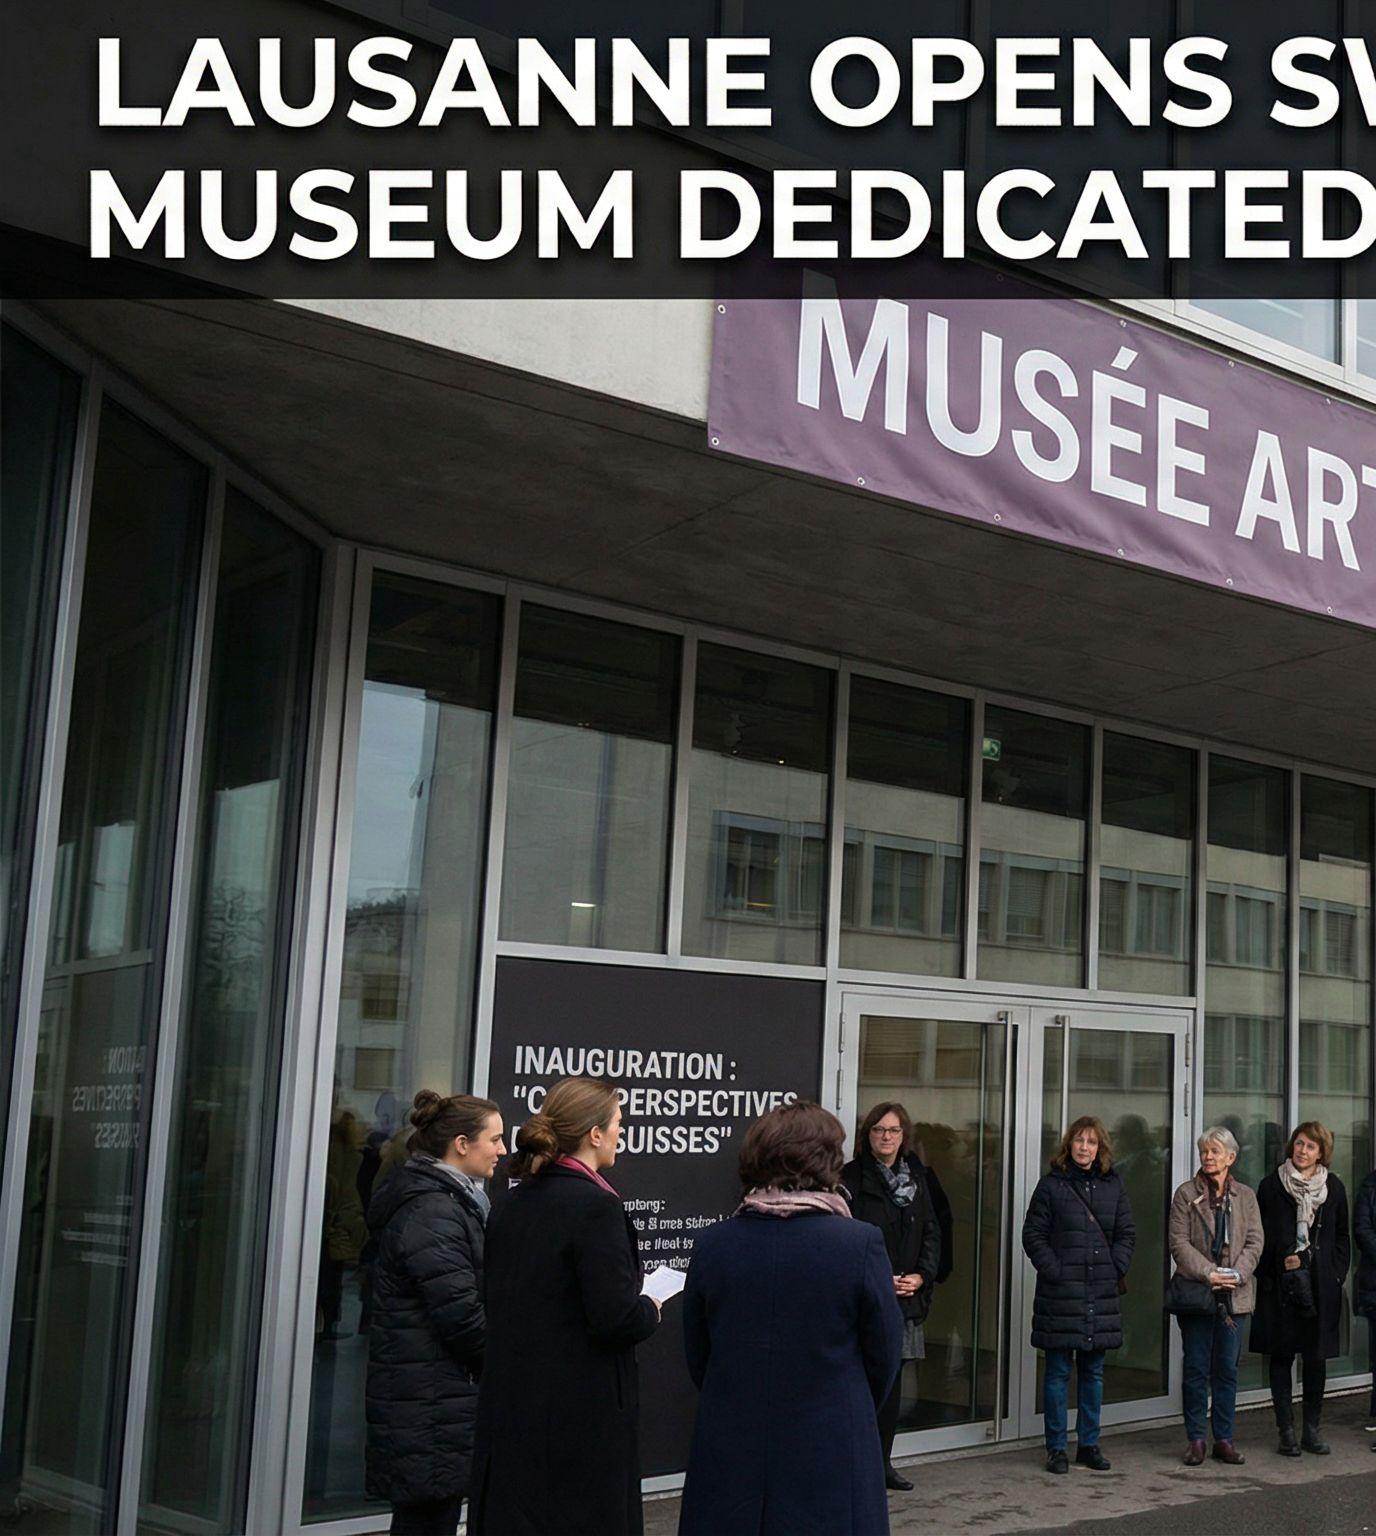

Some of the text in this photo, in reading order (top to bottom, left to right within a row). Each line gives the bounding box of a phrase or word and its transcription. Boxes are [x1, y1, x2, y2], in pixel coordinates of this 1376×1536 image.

[796, 270, 1210, 527] MUSÉE
[514, 1045, 723, 1080] INAUGURATION
[616, 1087, 798, 1118] PERSPECTIVES
